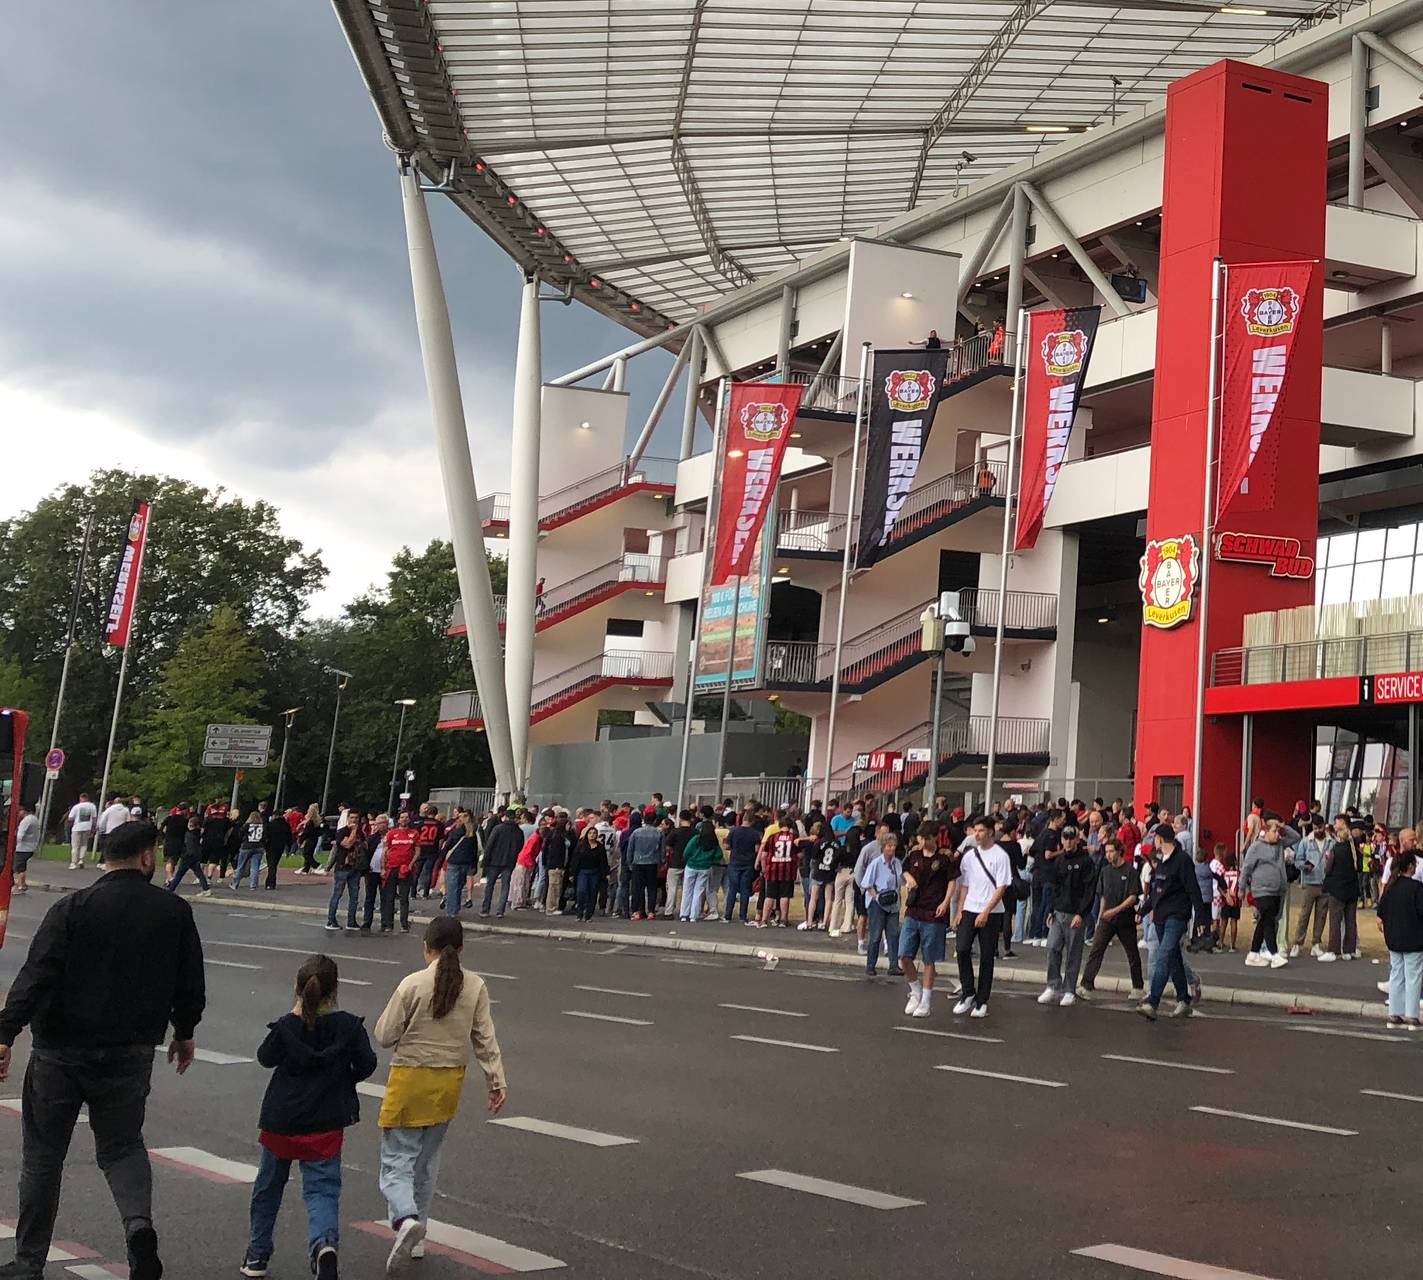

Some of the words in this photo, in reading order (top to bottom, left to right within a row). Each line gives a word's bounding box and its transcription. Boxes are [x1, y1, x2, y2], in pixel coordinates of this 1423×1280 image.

[1221, 535, 1298, 557] SCHWAD
[1275, 557, 1313, 576] BUD
[1157, 577, 1180, 588] BAYER
[1147, 605, 1186, 621] Leverkusen
[1377, 675, 1420, 699] SERVICE
[856, 754, 870, 769] OST
[870, 753, 886, 768] A/B
[420, 826, 438, 840] 20
[775, 841, 792, 858] 31
[823, 847, 834, 865] 8
